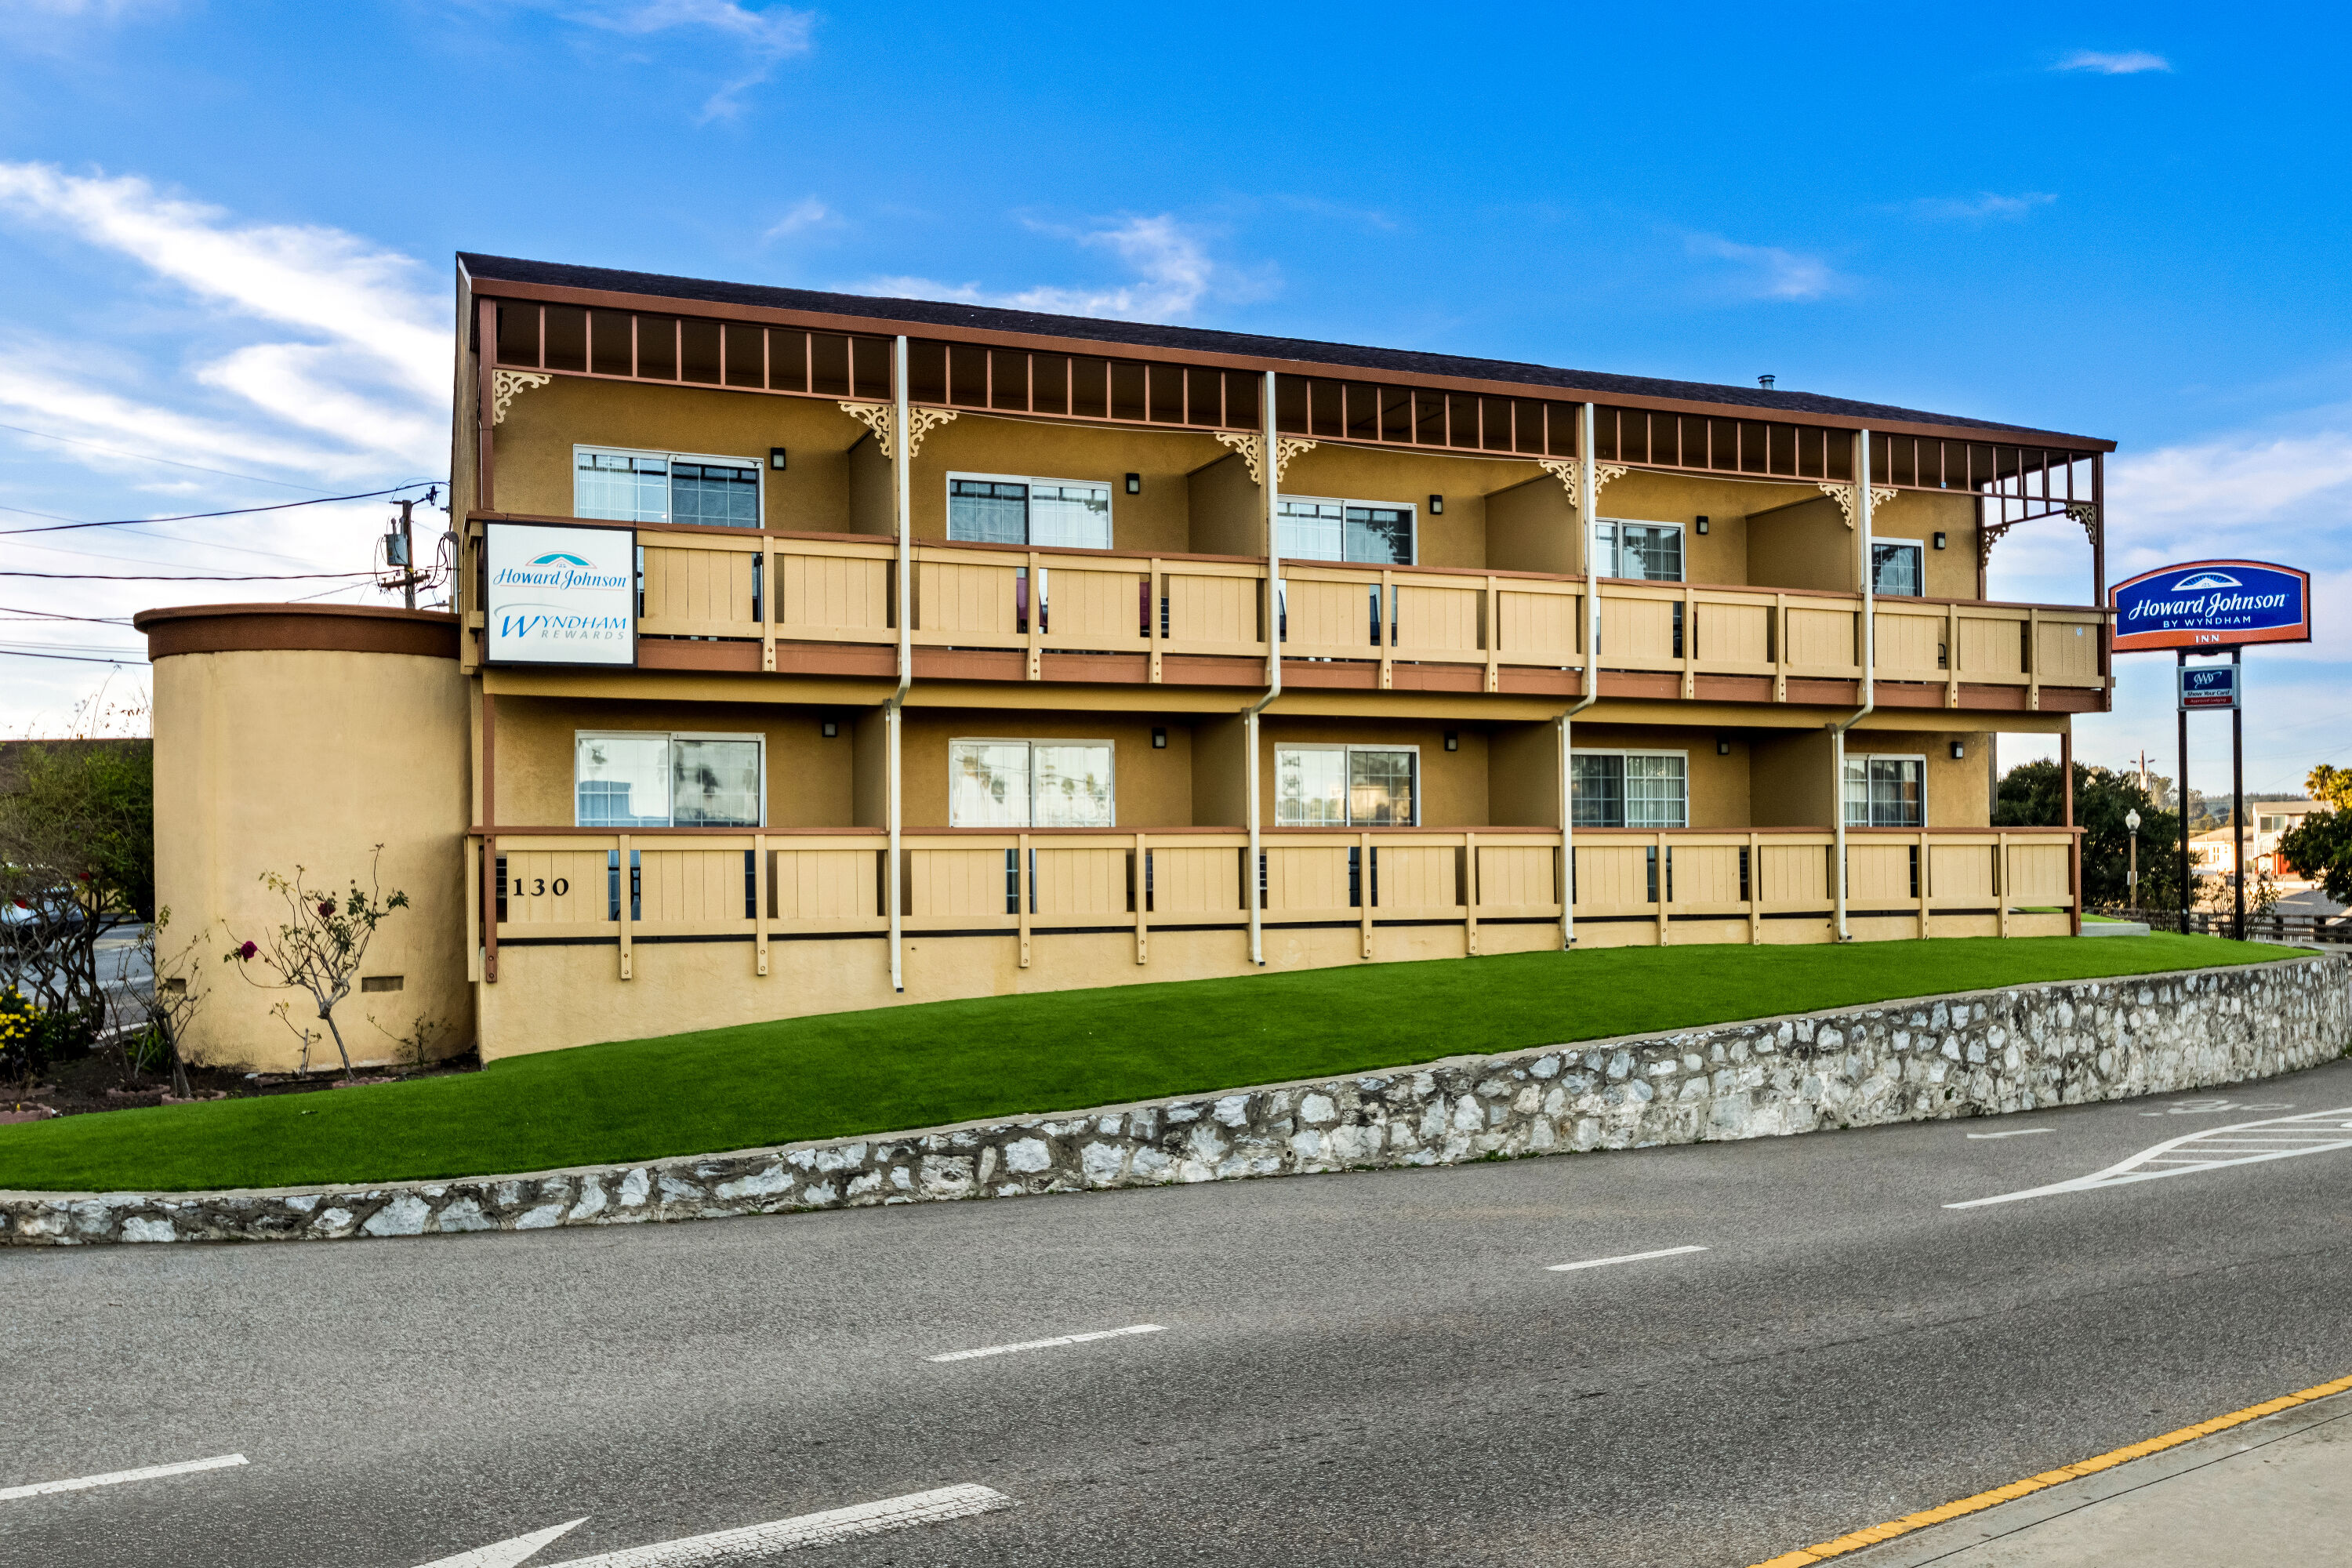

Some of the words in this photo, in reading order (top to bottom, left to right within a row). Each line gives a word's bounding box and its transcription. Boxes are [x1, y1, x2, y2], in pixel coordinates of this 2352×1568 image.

[493, 568, 561, 585] Howard
[560, 569, 626, 590] Johnson
[2129, 595, 2205, 620] Howard
[2205, 592, 2285, 618] Johnson
[502, 615, 626, 638] WYNDHAM
[2163, 620, 2178, 629] BY
[2184, 615, 2252, 627] WYNDHAM
[541, 630, 625, 641] REWARDS
[2195, 634, 2220, 644] INN
[514, 878, 569, 896] 130
